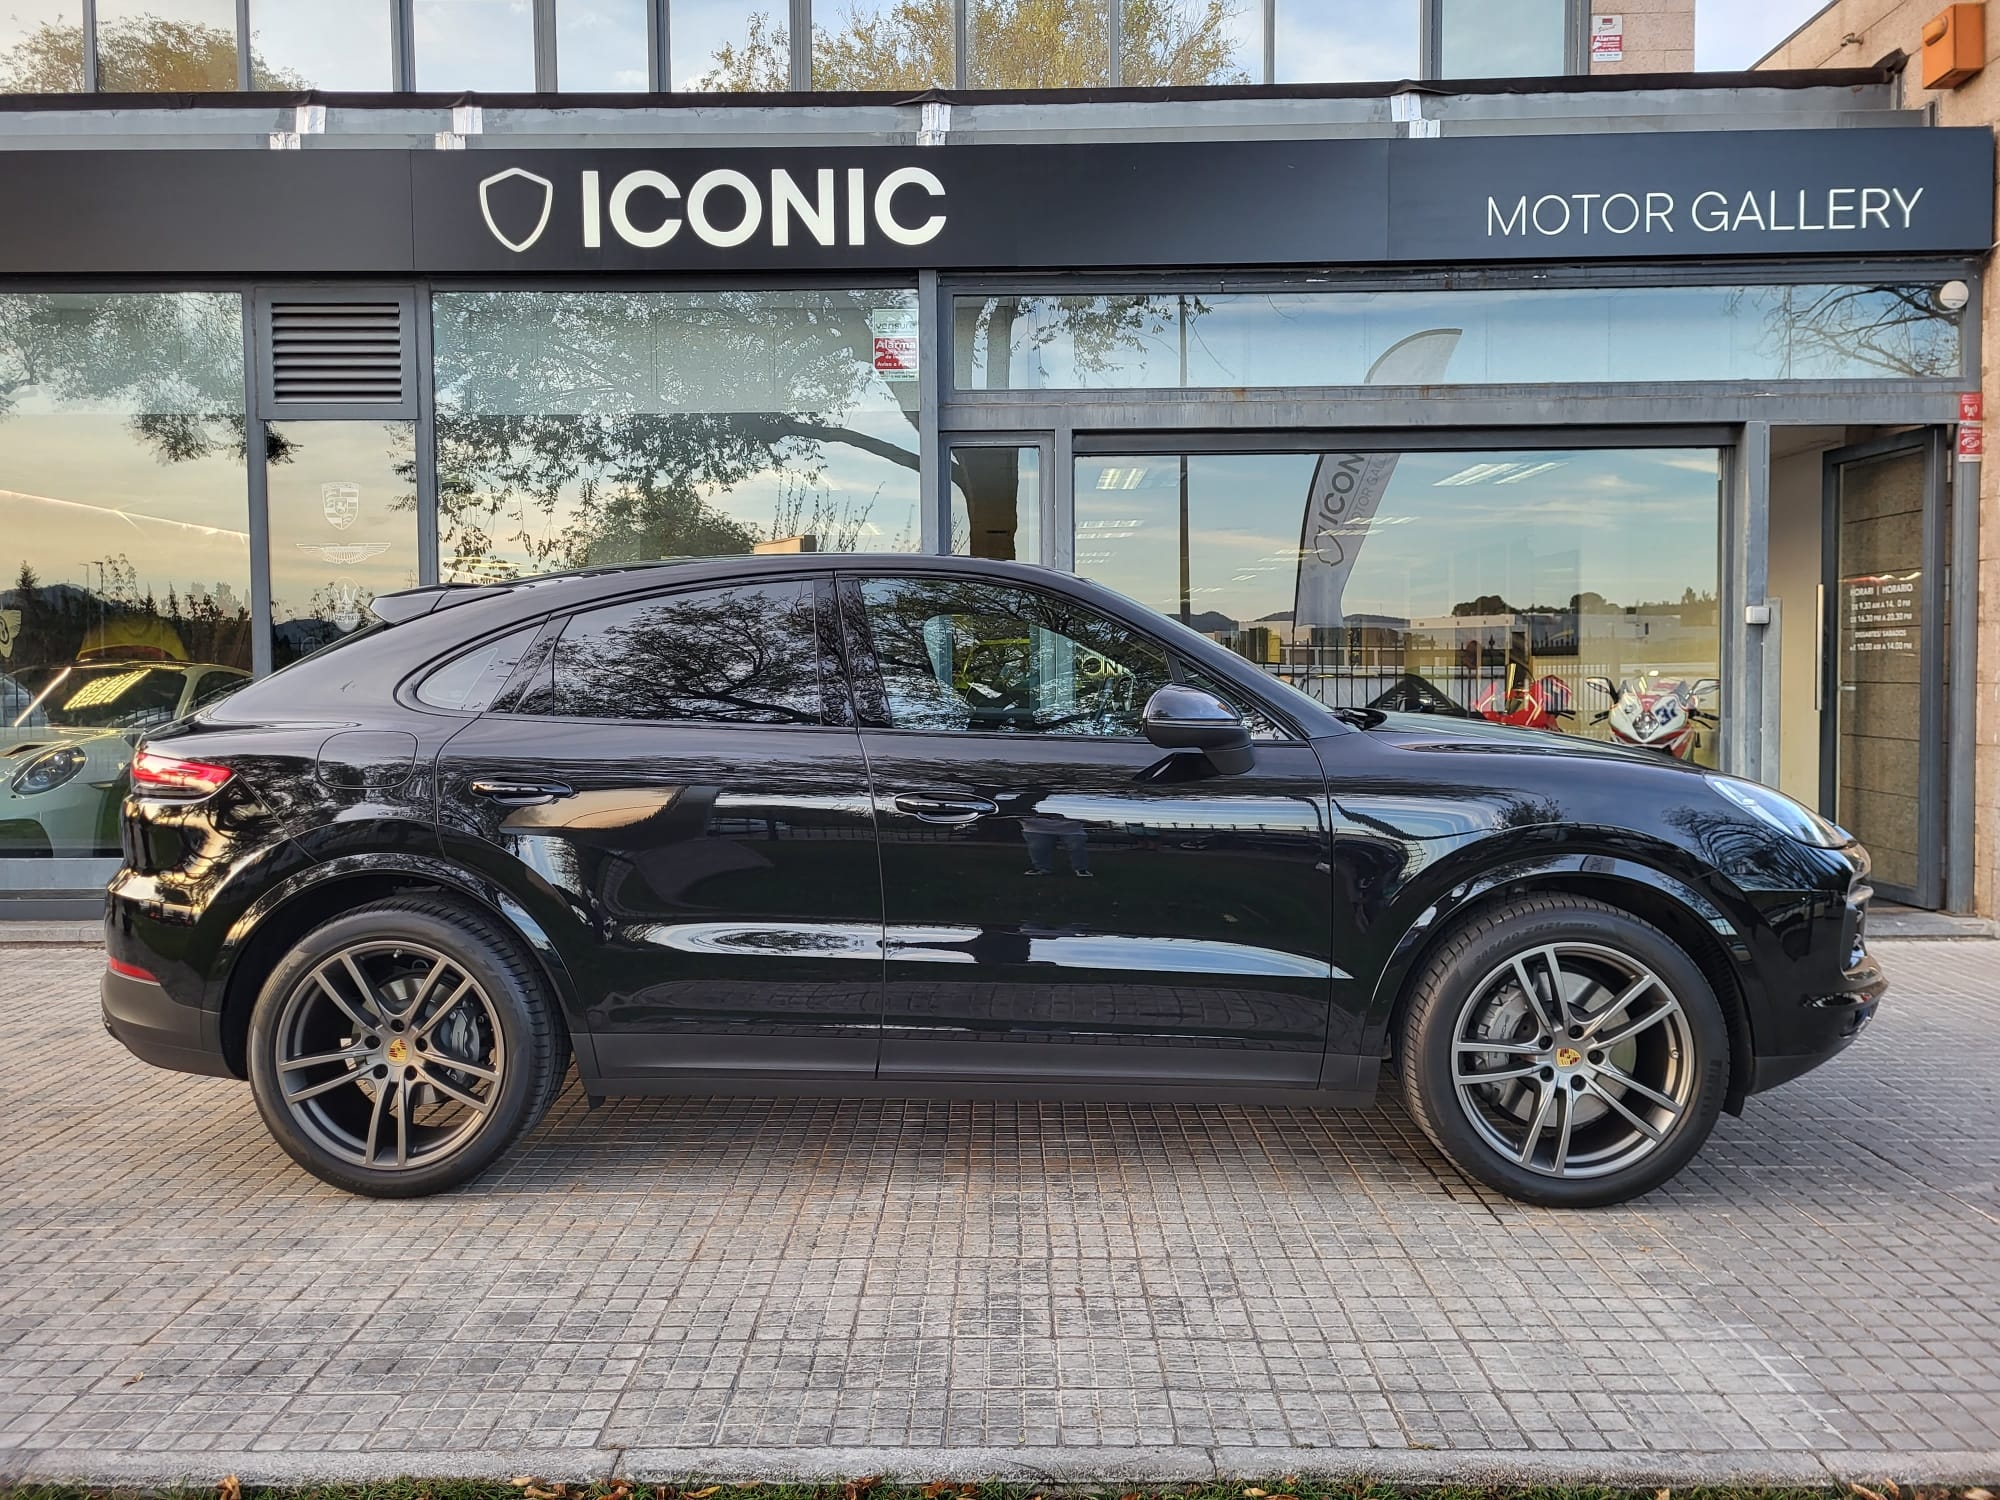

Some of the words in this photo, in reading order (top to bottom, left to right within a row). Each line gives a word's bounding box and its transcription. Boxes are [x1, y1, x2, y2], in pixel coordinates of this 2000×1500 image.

[582, 166, 947, 248] ICONIC
[1486, 192, 1675, 237] MOTOR
[1691, 187, 1925, 232] GALLERY
[875, 339, 916, 349] Alarma
[1882, 584, 1913, 594] HORARIO
